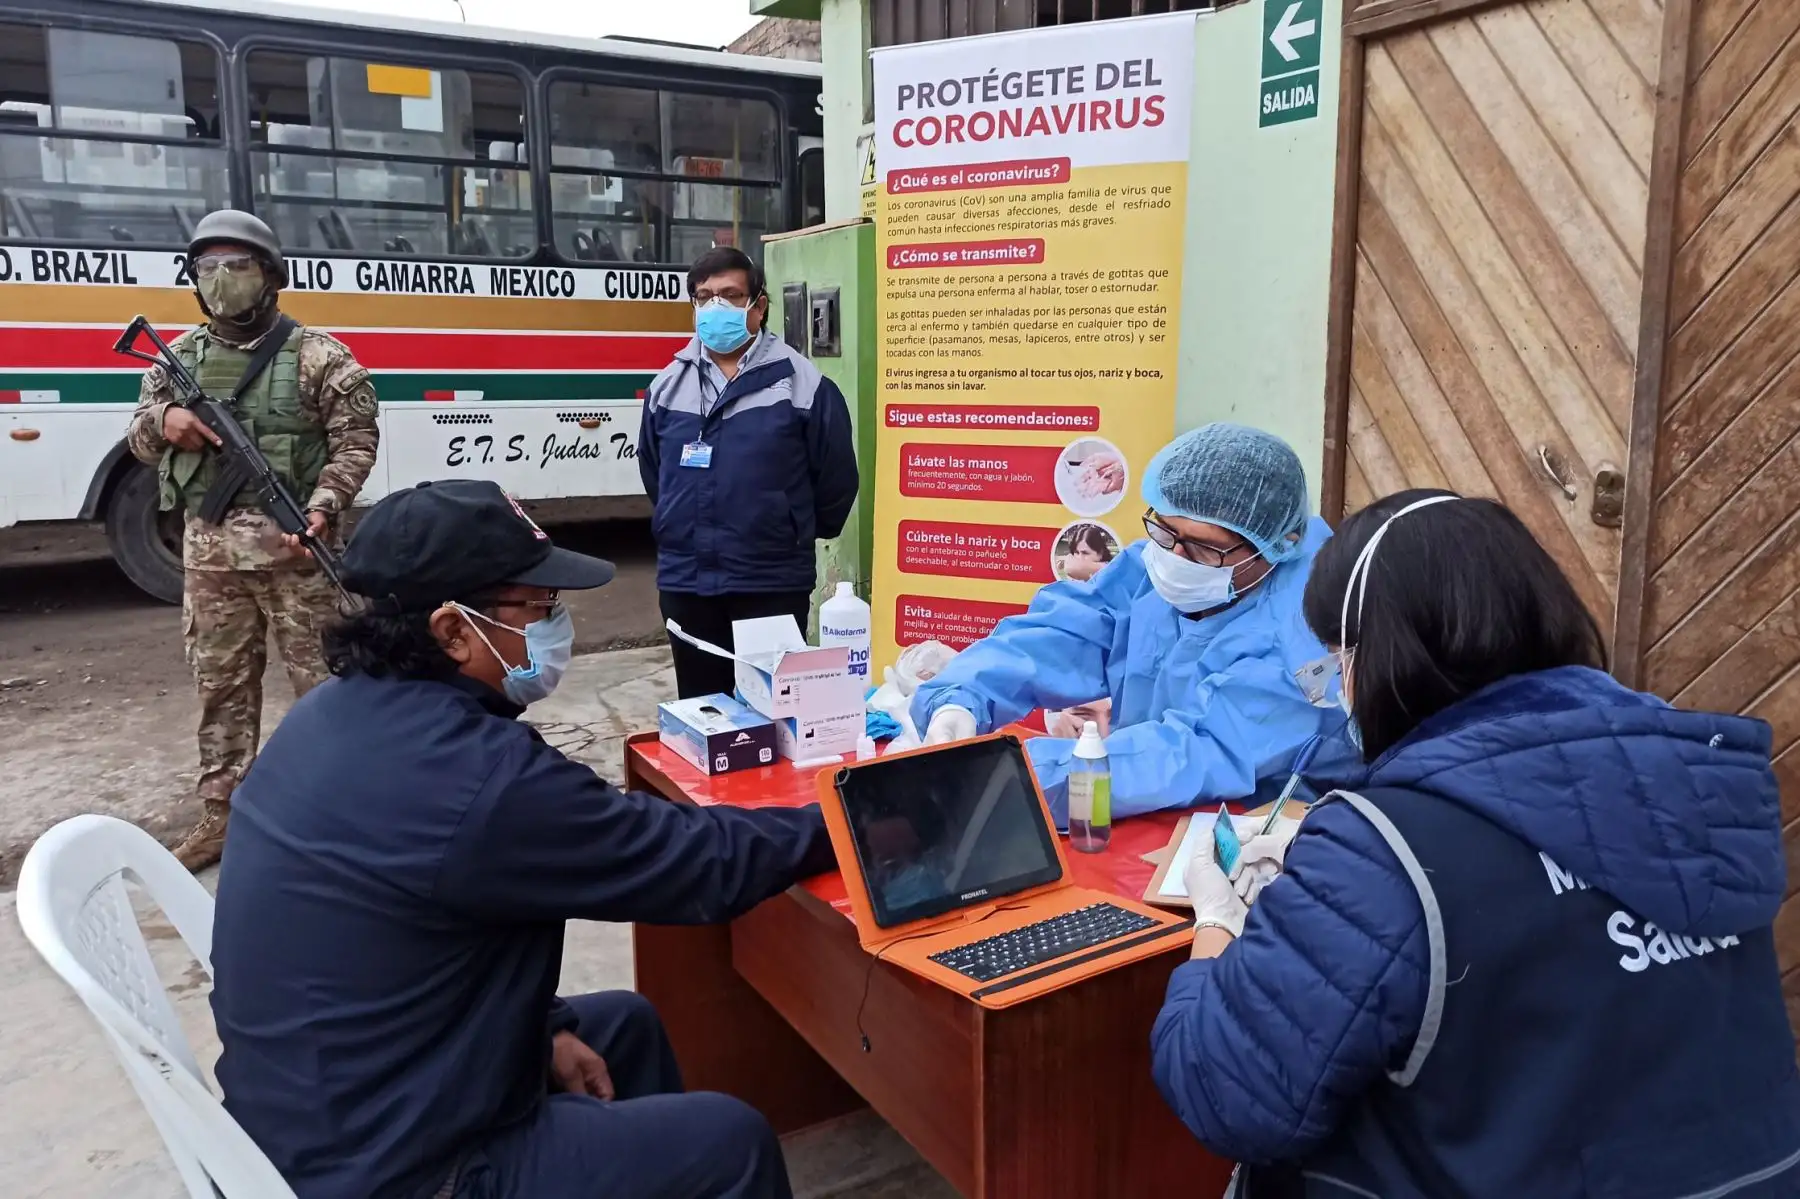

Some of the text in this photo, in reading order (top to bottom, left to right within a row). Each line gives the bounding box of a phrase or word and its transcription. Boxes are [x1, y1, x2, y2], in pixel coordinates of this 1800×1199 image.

[898, 58, 1163, 111] PROTÉGETE DEL
[1262, 84, 1316, 114] SALIDA
[892, 95, 1165, 148] CORONAVIRUS
[893, 163, 1059, 191] ¿Qué es el coronavirus?
[888, 201, 900, 210] Los
[903, 198, 955, 209] coronavirus
[959, 194, 984, 207] (CoV)
[988, 195, 1003, 203] son
[1008, 194, 1025, 202] una
[1030, 190, 1063, 203] amplia
[1067, 187, 1099, 199] familia
[1103, 186, 1116, 196] de
[1120, 185, 1145, 195] virus
[1150, 185, 1171, 196] que
[888, 212, 919, 224] pueden
[927, 212, 956, 221] causar
[964, 208, 1000, 219] diversas
[1008, 203, 1061, 217] afecciones,
[1070, 201, 1098, 213] desde
[1106, 200, 1115, 210] el
[1124, 197, 1170, 210] resfriado
[917, 224, 940, 234] hasta
[944, 222, 993, 233] infecciones
[996, 219, 1057, 232] respiratorias
[1060, 217, 1079, 227] más
[1082, 216, 1116, 228] graves.
[893, 243, 1035, 266] ¿Cómo se transmite?
[31, 250, 138, 284] BRAZIL
[173, 255, 190, 286] 2
[356, 261, 475, 294] GAMARRA
[490, 268, 576, 297] MEXICO
[604, 271, 681, 300] CIUDAD
[886, 277, 895, 286] Se
[898, 276, 940, 285] transmite
[944, 274, 955, 284] de
[959, 275, 997, 285] persona
[1008, 273, 1047, 283] persona
[1051, 273, 1058, 281] a
[1061, 270, 1089, 280] través
[1093, 268, 1105, 279] de
[1109, 269, 1144, 280] gotitas
[1148, 269, 1168, 279] que
[886, 288, 917, 300] expulsa
[939, 289, 976, 298] persona
[979, 285, 1017, 296] enferma
[1020, 285, 1028, 295] al
[1031, 284, 1063, 295] hablar,
[1066, 285, 1090, 294] toser
[1093, 285, 1099, 293] o
[1101, 282, 1158, 292] estornudar.
[886, 303, 1166, 320] Las gotitas pueden ser inhaladas por las personas que están
[886, 317, 1166, 332] cerca al enfermo y también quedarse en cualquier tipo de
[886, 335, 927, 345] superficie
[929, 334, 986, 345] (pasamanos,
[990, 335, 1022, 344] mesas,
[1027, 333, 1072, 344] lapiceros,
[1076, 334, 1101, 342] entre
[1105, 331, 1134, 343] otros)
[1139, 334, 1145, 344] y
[886, 348, 916, 357] tocadas
[937, 348, 949, 356] las
[886, 368, 892, 377] El
[894, 368, 914, 376] virus
[916, 368, 949, 379] ingresa
[951, 370, 958, 378] a
[959, 369, 968, 377] tu
[970, 368, 1019, 378] organismo
[1022, 368, 1030, 377] al
[1076, 368, 1098, 379] ojos,
[1100, 367, 1124, 377] nariz
[1127, 370, 1134, 380] y
[1135, 368, 1163, 379] boca,
[900, 380, 912, 389] las
[947, 381, 959, 390] sin
[962, 381, 985, 390] lavar.
[889, 409, 1092, 425] Sigue estas recomendaciones:
[540, 433, 601, 469] Judas
[610, 432, 638, 460] Ta
[908, 454, 1007, 469] Lávate las manos
[907, 479, 983, 492] mínimo 20 segundos.
[908, 469, 968, 480] frecuentemente,
[984, 473, 1003, 481] agua
[1004, 474, 1010, 484] y
[1010, 472, 1034, 483] jabón,
[906, 530, 1040, 551] Cúbrete la nariz y boca
[905, 555, 950, 566] desechable,
[951, 558, 959, 566] al
[961, 560, 1003, 570] estornudar
[904, 604, 930, 617] Evita
[933, 611, 959, 620] saludar
[973, 616, 995, 624] mano
[1538, 851, 1593, 895] M
